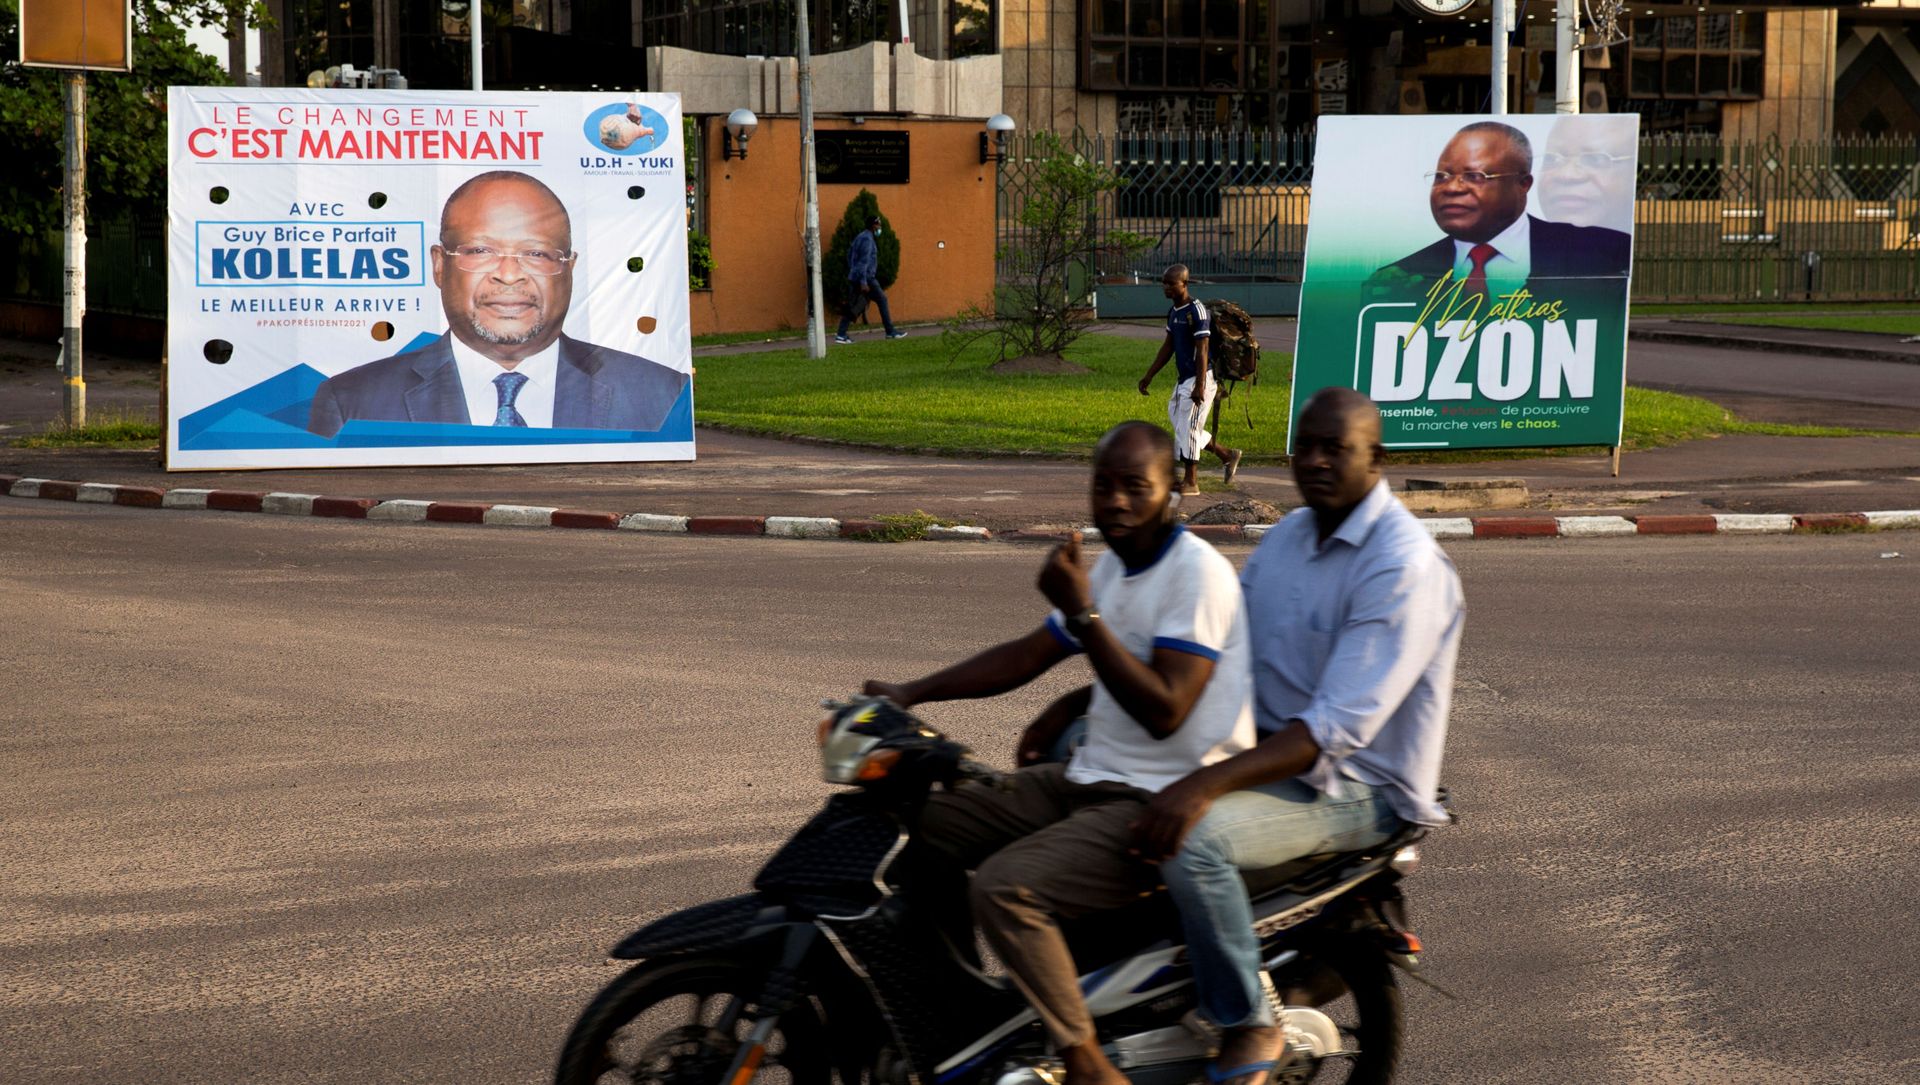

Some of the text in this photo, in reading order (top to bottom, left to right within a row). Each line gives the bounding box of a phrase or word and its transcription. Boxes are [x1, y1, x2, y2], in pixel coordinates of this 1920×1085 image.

[213, 106, 529, 128] LE CHANGEMENT
[187, 127, 544, 161] C'EST MAINTENANT
[580, 157, 622, 169] U.D.H
[638, 157, 674, 169] YUKI
[289, 202, 345, 217] AVEC
[223, 226, 398, 246] Guy Brice Parfait
[211, 247, 411, 280] KOLELAS
[201, 298, 221, 313] LE
[230, 298, 324, 313] MEILLEUR
[334, 298, 407, 312] ARRIVE
[1403, 268, 1567, 348] Mathias
[256, 317, 367, 328] #PAKOPRÉSIDENT2021
[1369, 318, 1598, 402] DZON
[1501, 405, 1520, 416] de
[1522, 404, 1590, 418] poursuivre
[1401, 418, 1560, 431] la marche vers le chaos.
